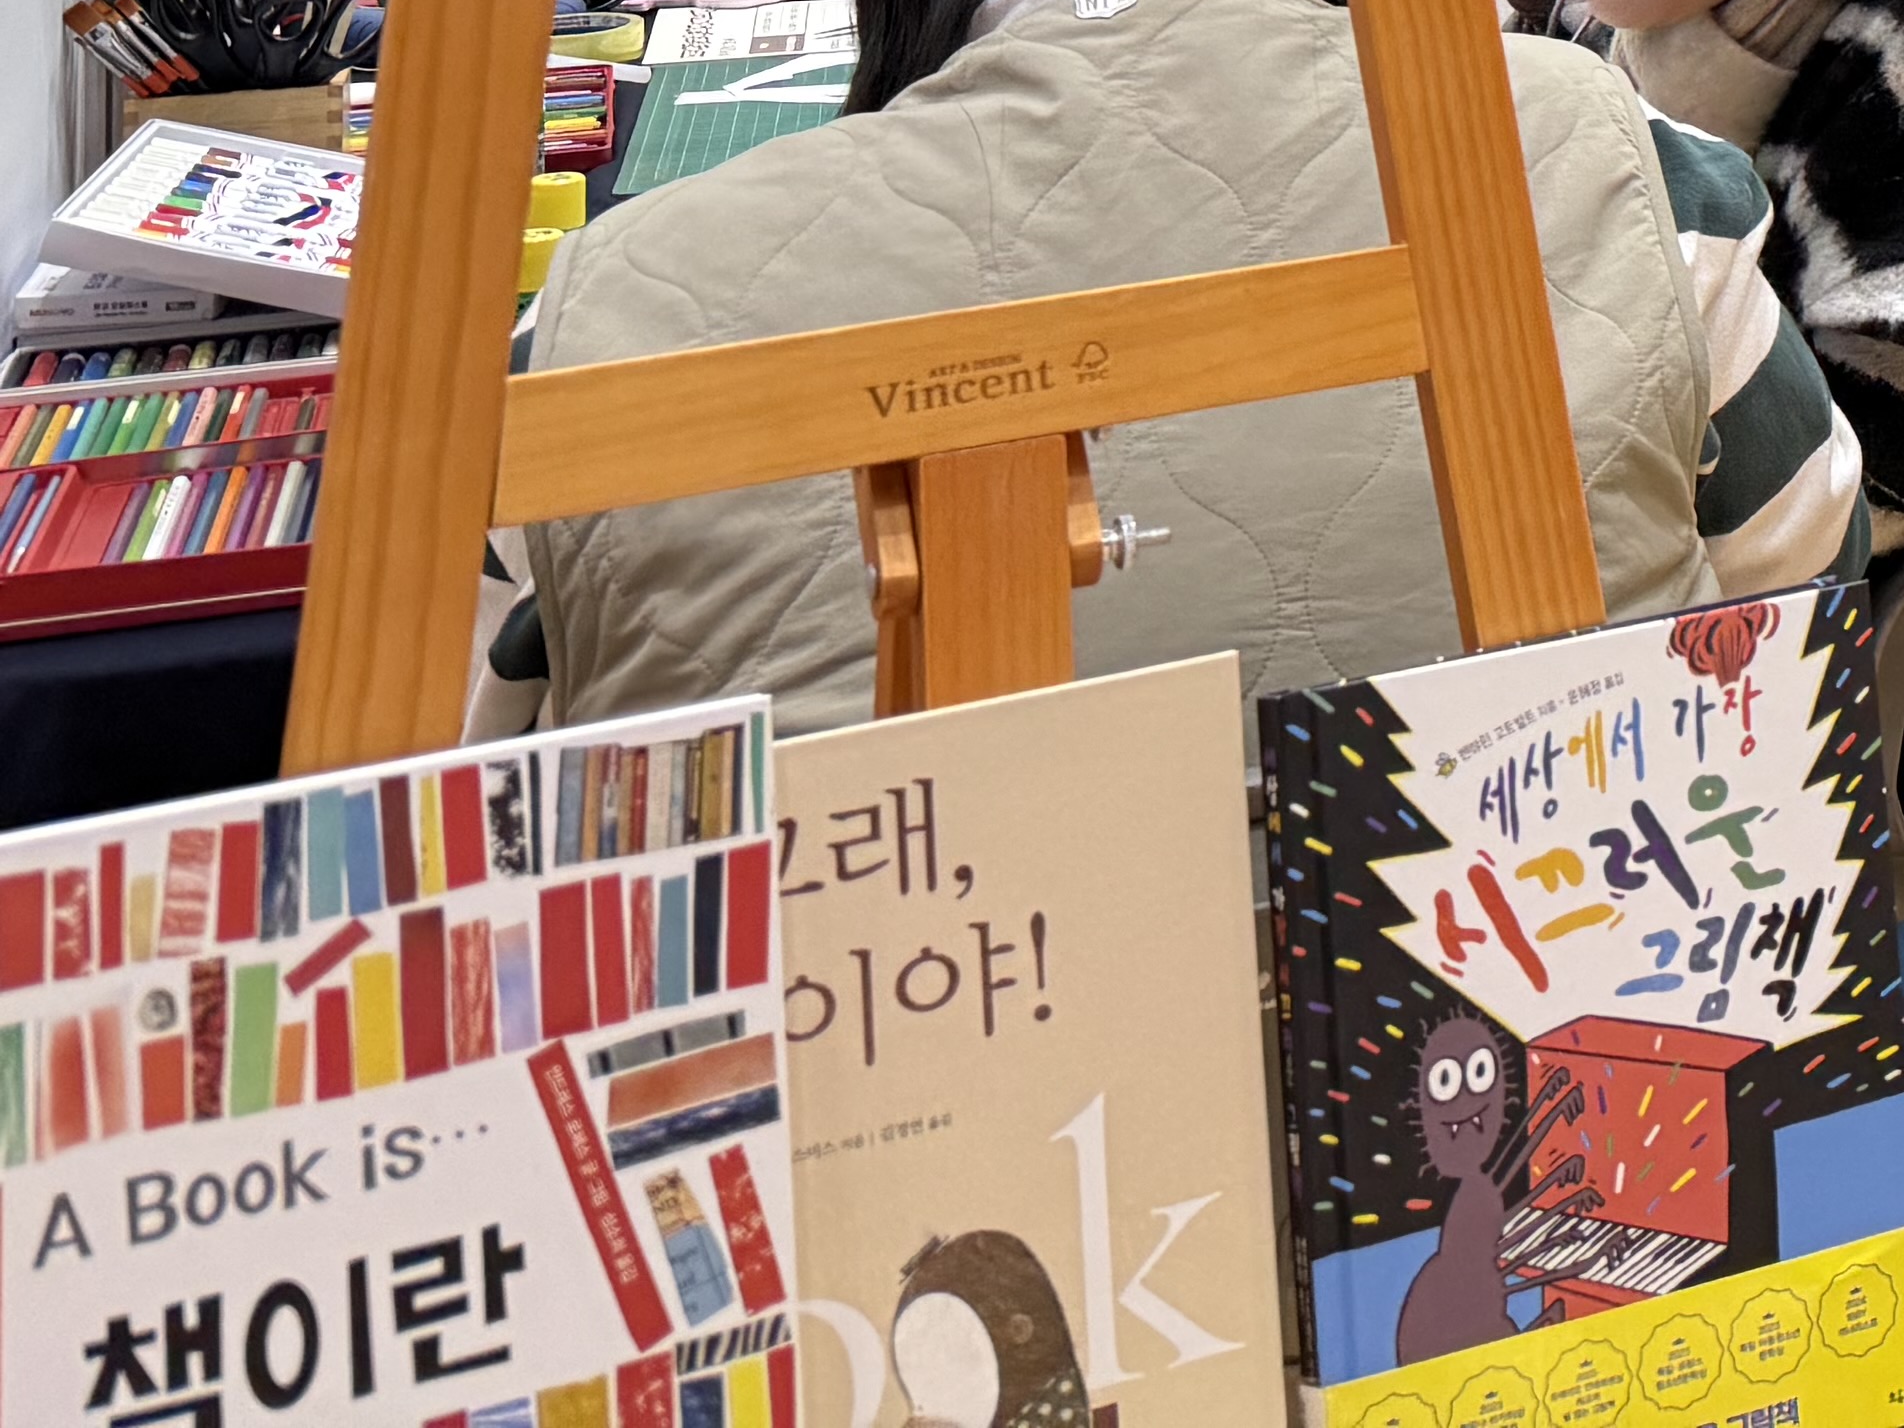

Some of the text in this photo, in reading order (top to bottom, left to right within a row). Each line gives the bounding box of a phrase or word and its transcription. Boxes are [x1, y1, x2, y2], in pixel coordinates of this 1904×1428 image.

[866, 359, 1057, 418] Vincent
[1478, 675, 1763, 844] 세상에서 가장
[1435, 774, 1788, 994] 시끄러운
[1614, 888, 1828, 1024] 그림책
[33, 1192, 92, 1270] A
[126, 1142, 330, 1250] Book
[84, 1223, 528, 1428] 책이란
